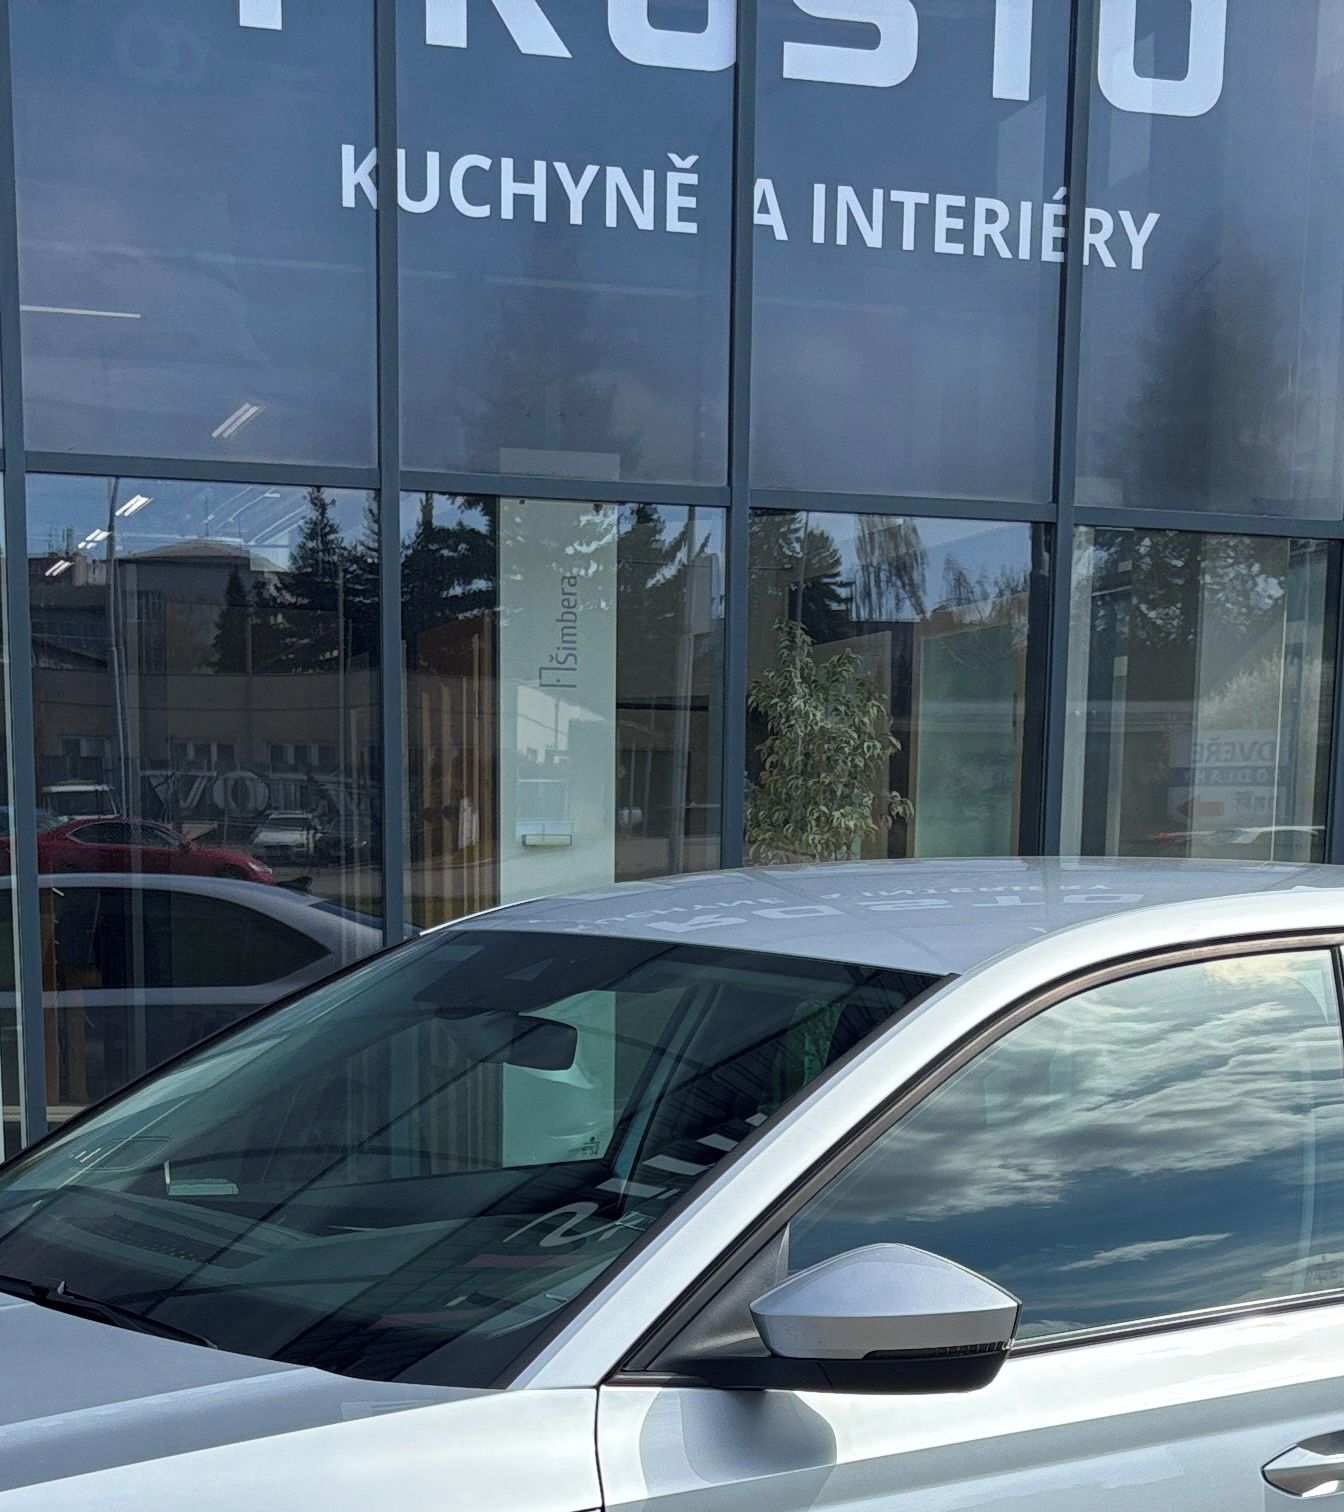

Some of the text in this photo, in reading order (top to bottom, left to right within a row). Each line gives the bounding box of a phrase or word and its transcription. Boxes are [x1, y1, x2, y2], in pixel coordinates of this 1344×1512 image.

[341, 144, 1161, 270] KUCHYNĚ A INTERIÉRY
[549, 575, 578, 665] Šimbera
